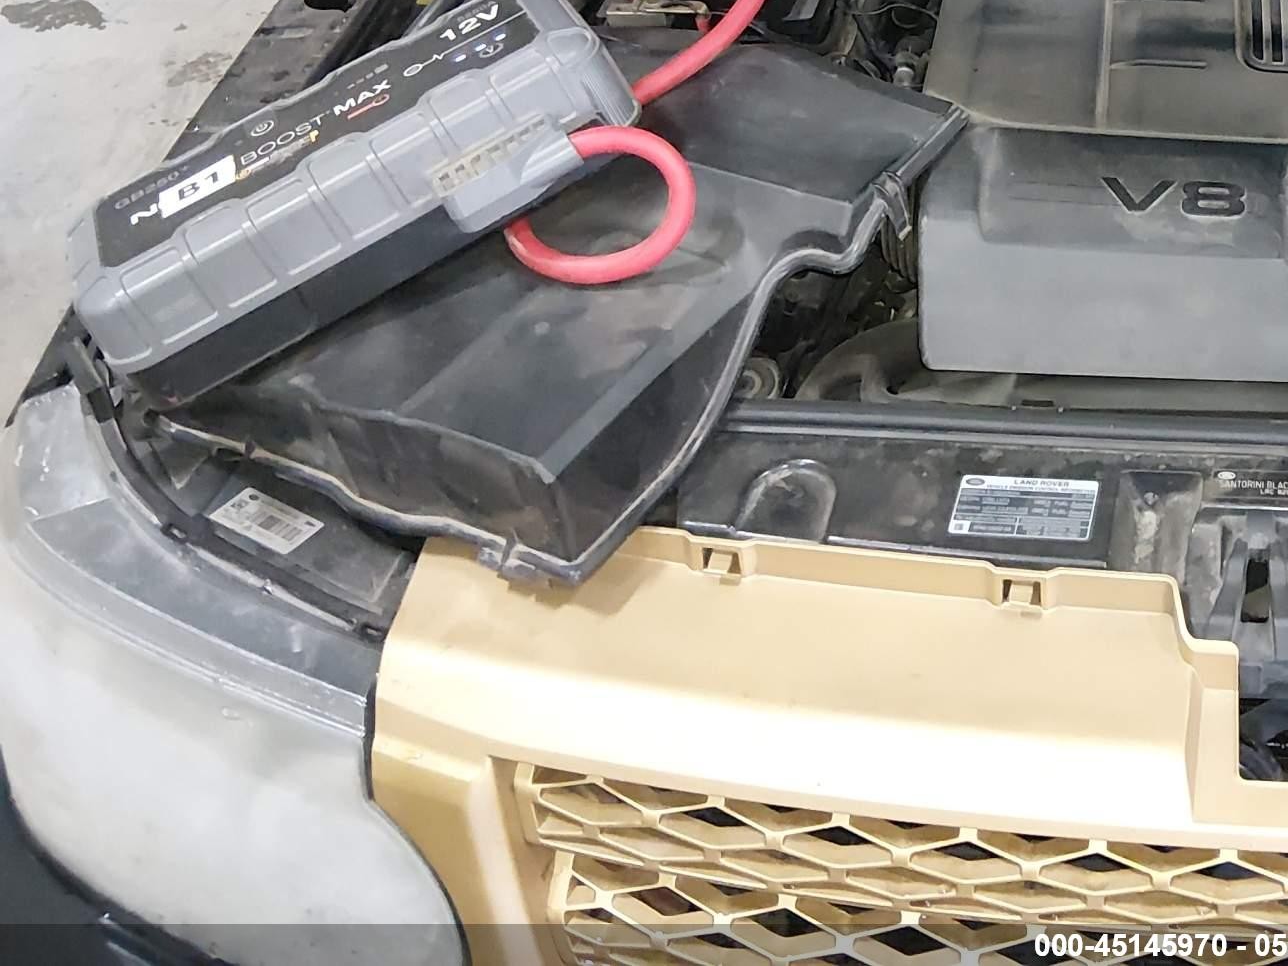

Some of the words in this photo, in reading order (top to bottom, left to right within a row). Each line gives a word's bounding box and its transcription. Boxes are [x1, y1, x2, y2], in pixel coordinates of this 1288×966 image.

[440, 3, 499, 42] 12V
[240, 113, 325, 166] BOOST
[332, 79, 392, 116] MAX
[1101, 176, 1247, 217] V8
